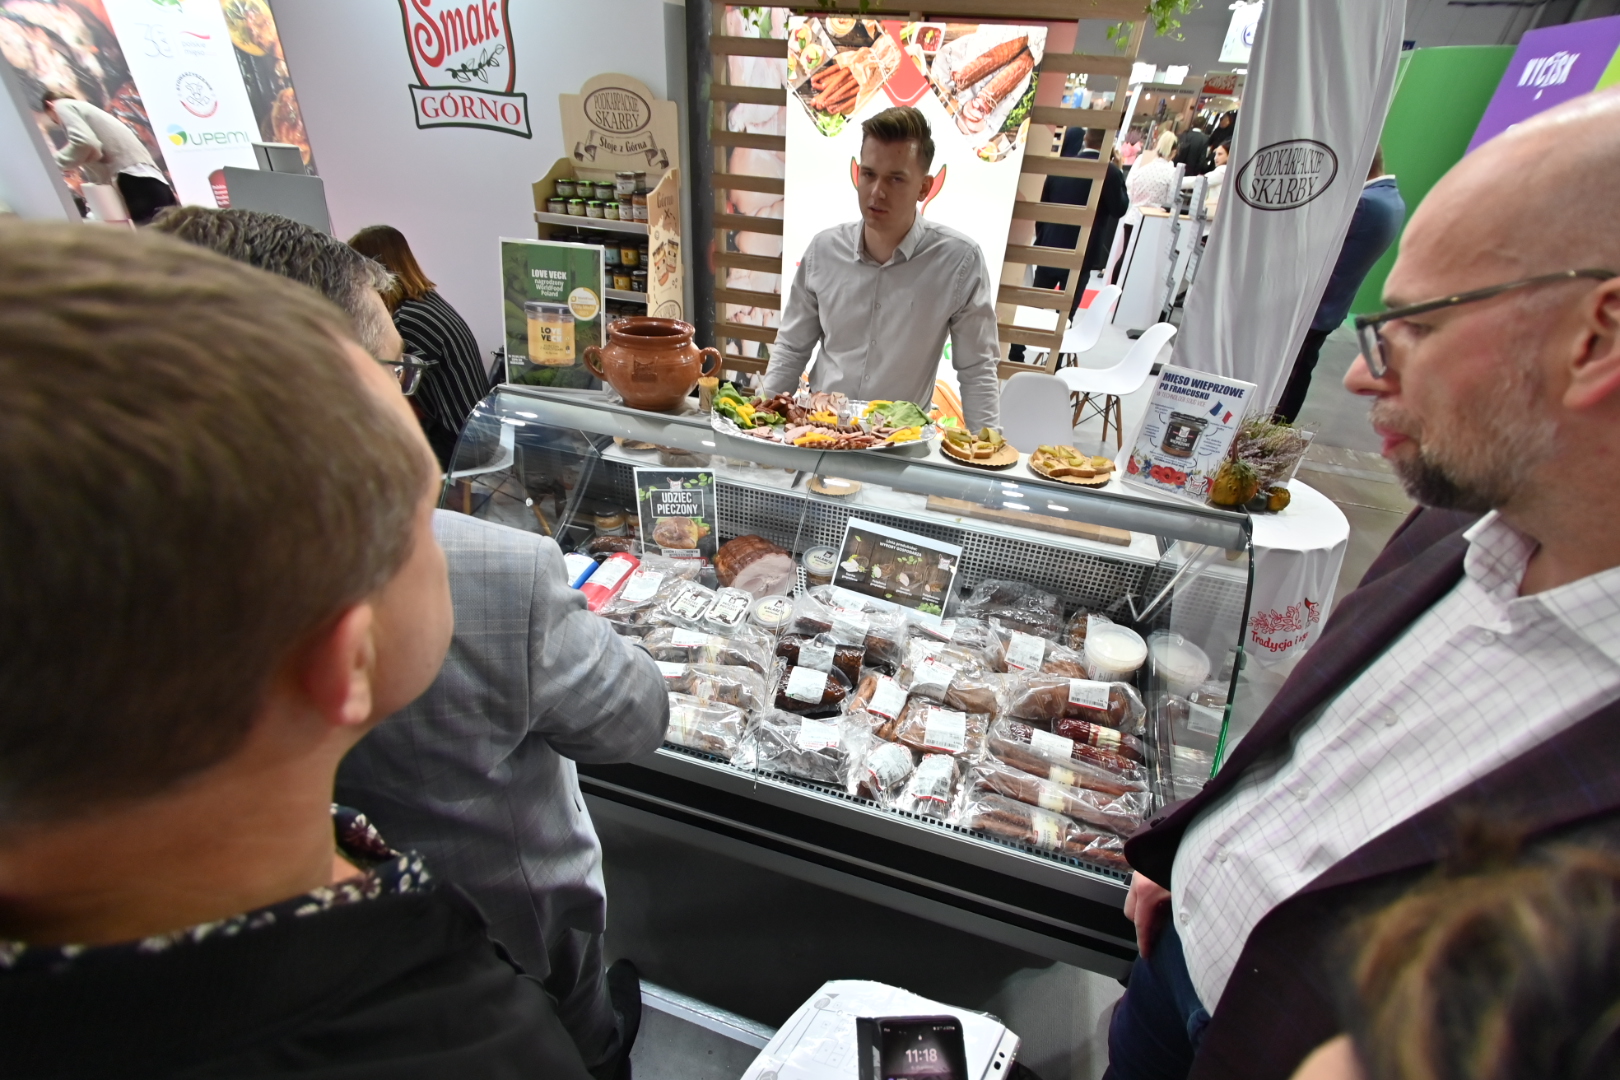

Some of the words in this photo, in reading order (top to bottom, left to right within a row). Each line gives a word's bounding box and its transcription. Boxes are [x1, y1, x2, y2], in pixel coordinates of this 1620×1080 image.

[411, 0, 499, 67] Smak
[420, 92, 521, 125] GÓRNO
[593, 92, 640, 112] PODKARPACKIE
[595, 110, 640, 130] SKARBY
[1253, 147, 1325, 176] PODKARPACKIE
[1248, 177, 1319, 204] SKARBY
[531, 269, 548, 279] LOVE
[549, 271, 567, 280] VECK
[1158, 382, 1169, 391] PO
[1168, 385, 1211, 400] FRANCUSKU
[1162, 372, 1191, 386] MIĘSO
[1191, 378, 1245, 399] WIEPRZOWE
[661, 492, 692, 503] UDZIEC
[656, 503, 698, 515] PIECZONY
[1251, 630, 1293, 653] Tradycja
[905, 1048, 938, 1063] 11:18
